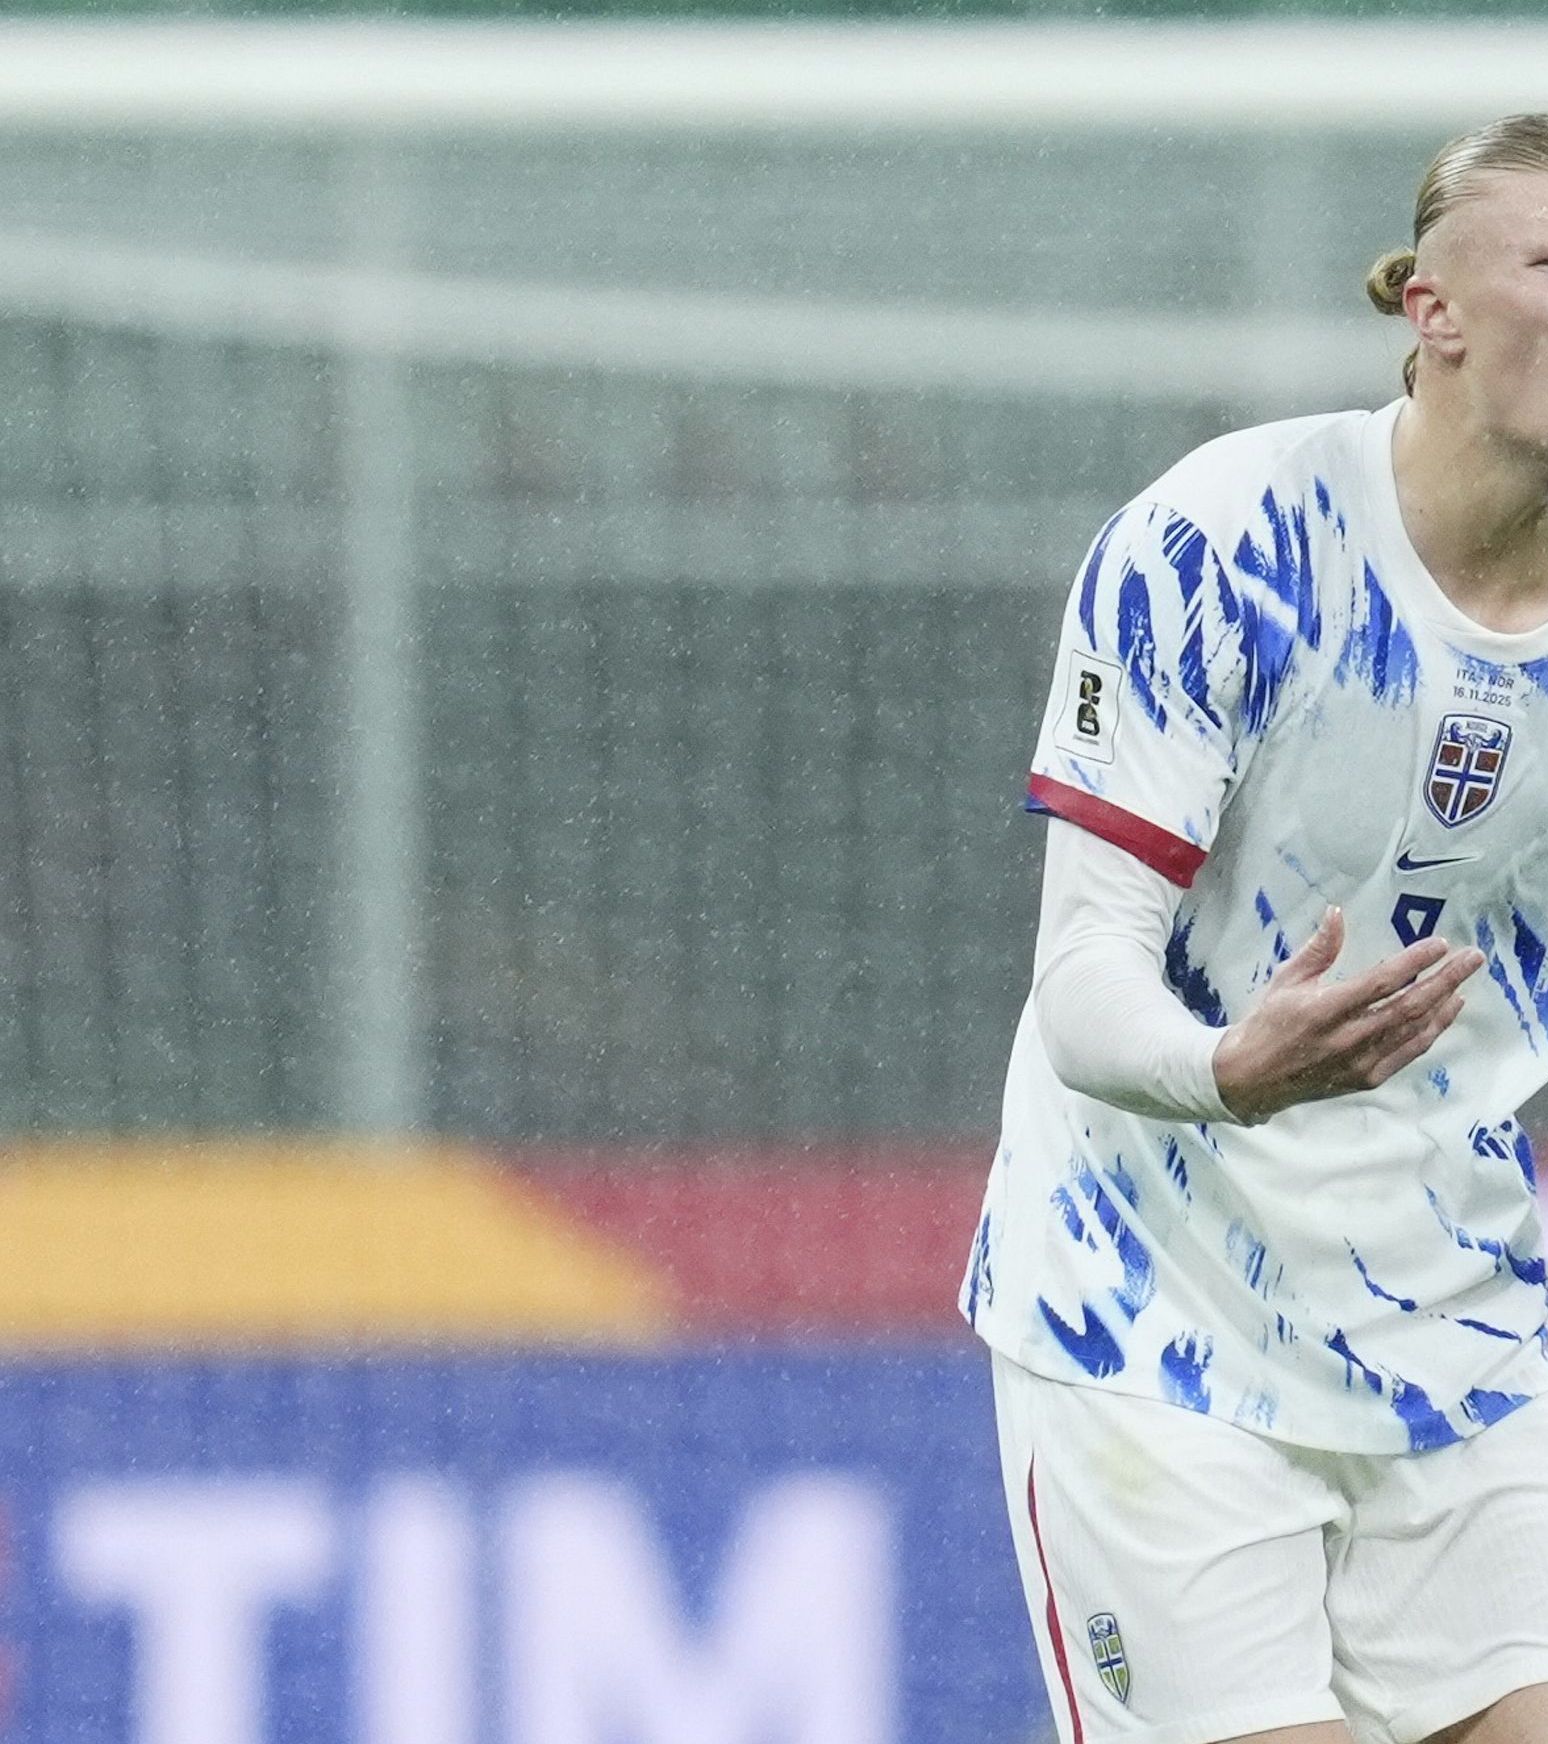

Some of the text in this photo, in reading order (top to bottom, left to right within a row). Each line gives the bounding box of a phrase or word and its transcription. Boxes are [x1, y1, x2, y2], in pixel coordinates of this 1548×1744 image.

[1456, 668, 1477, 682] ITA
[1488, 674, 1515, 689] NOR
[1453, 685, 1512, 707] 16.11.2025
[52, 1472, 894, 1744] TIM
